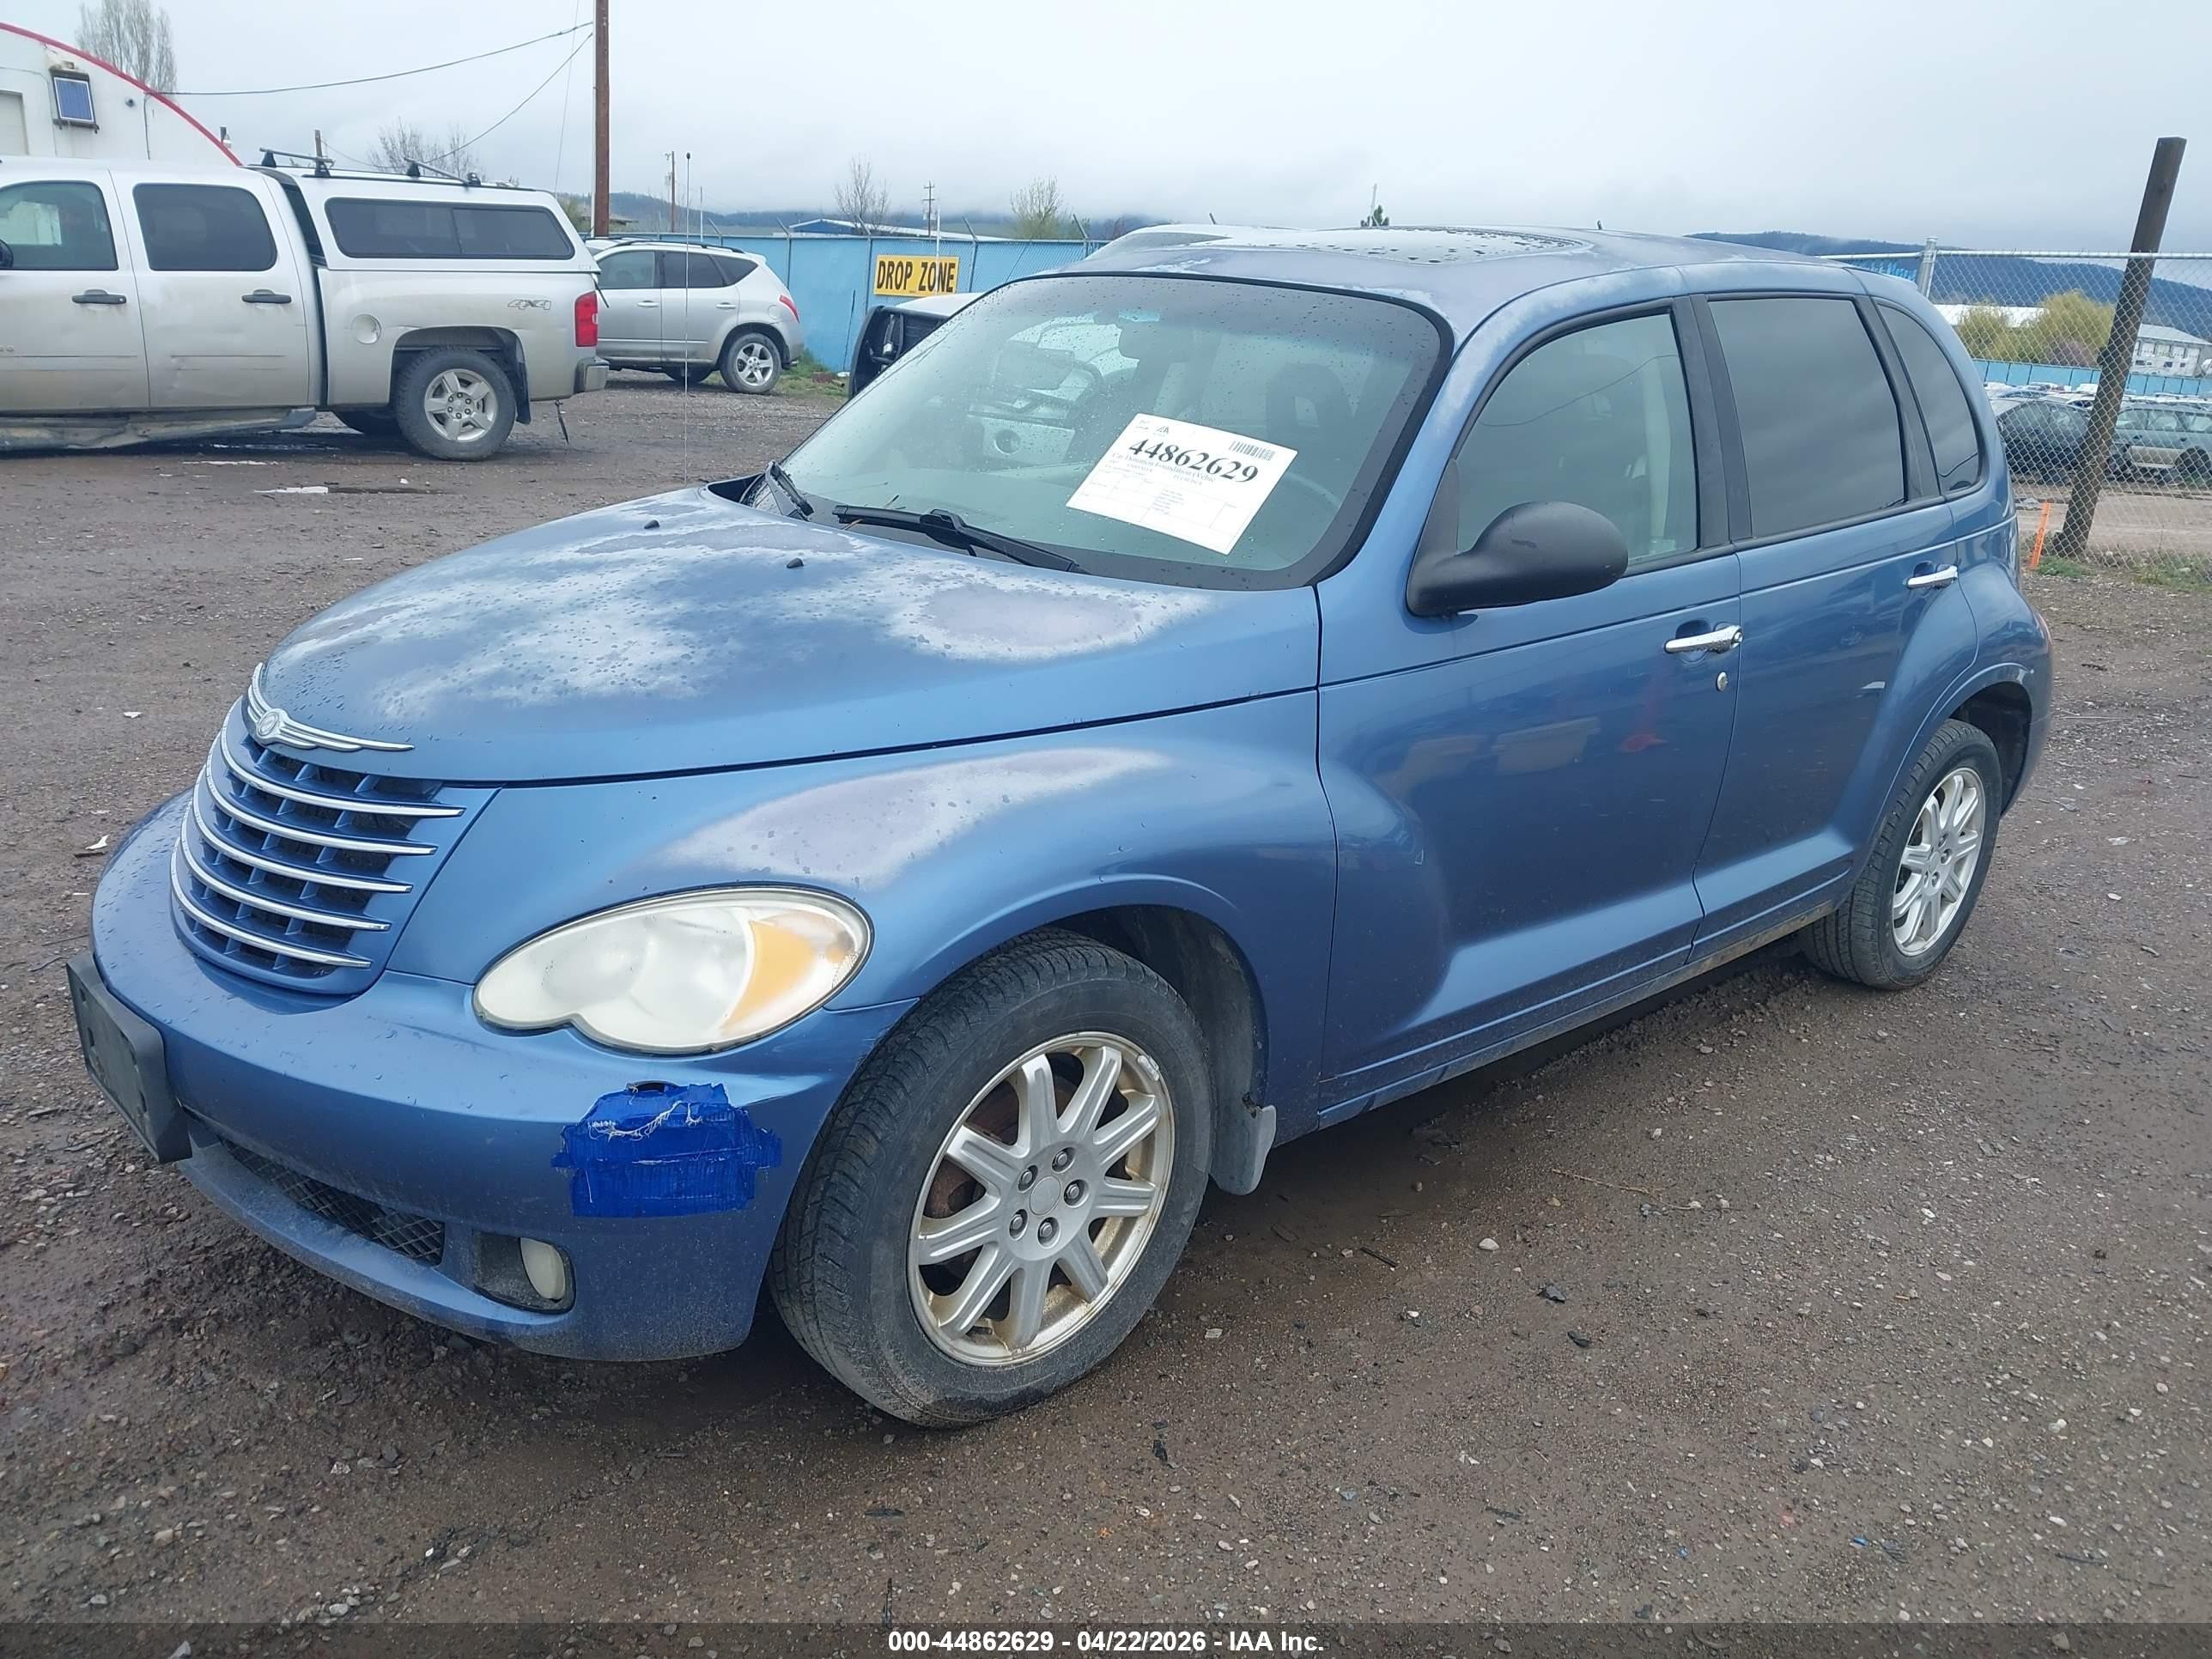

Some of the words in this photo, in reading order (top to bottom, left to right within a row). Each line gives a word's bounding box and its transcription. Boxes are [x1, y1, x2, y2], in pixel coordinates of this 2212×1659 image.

[876, 260, 913, 290] DROP
[918, 261, 956, 292] ZONE
[1128, 438, 1259, 483] 44862629
